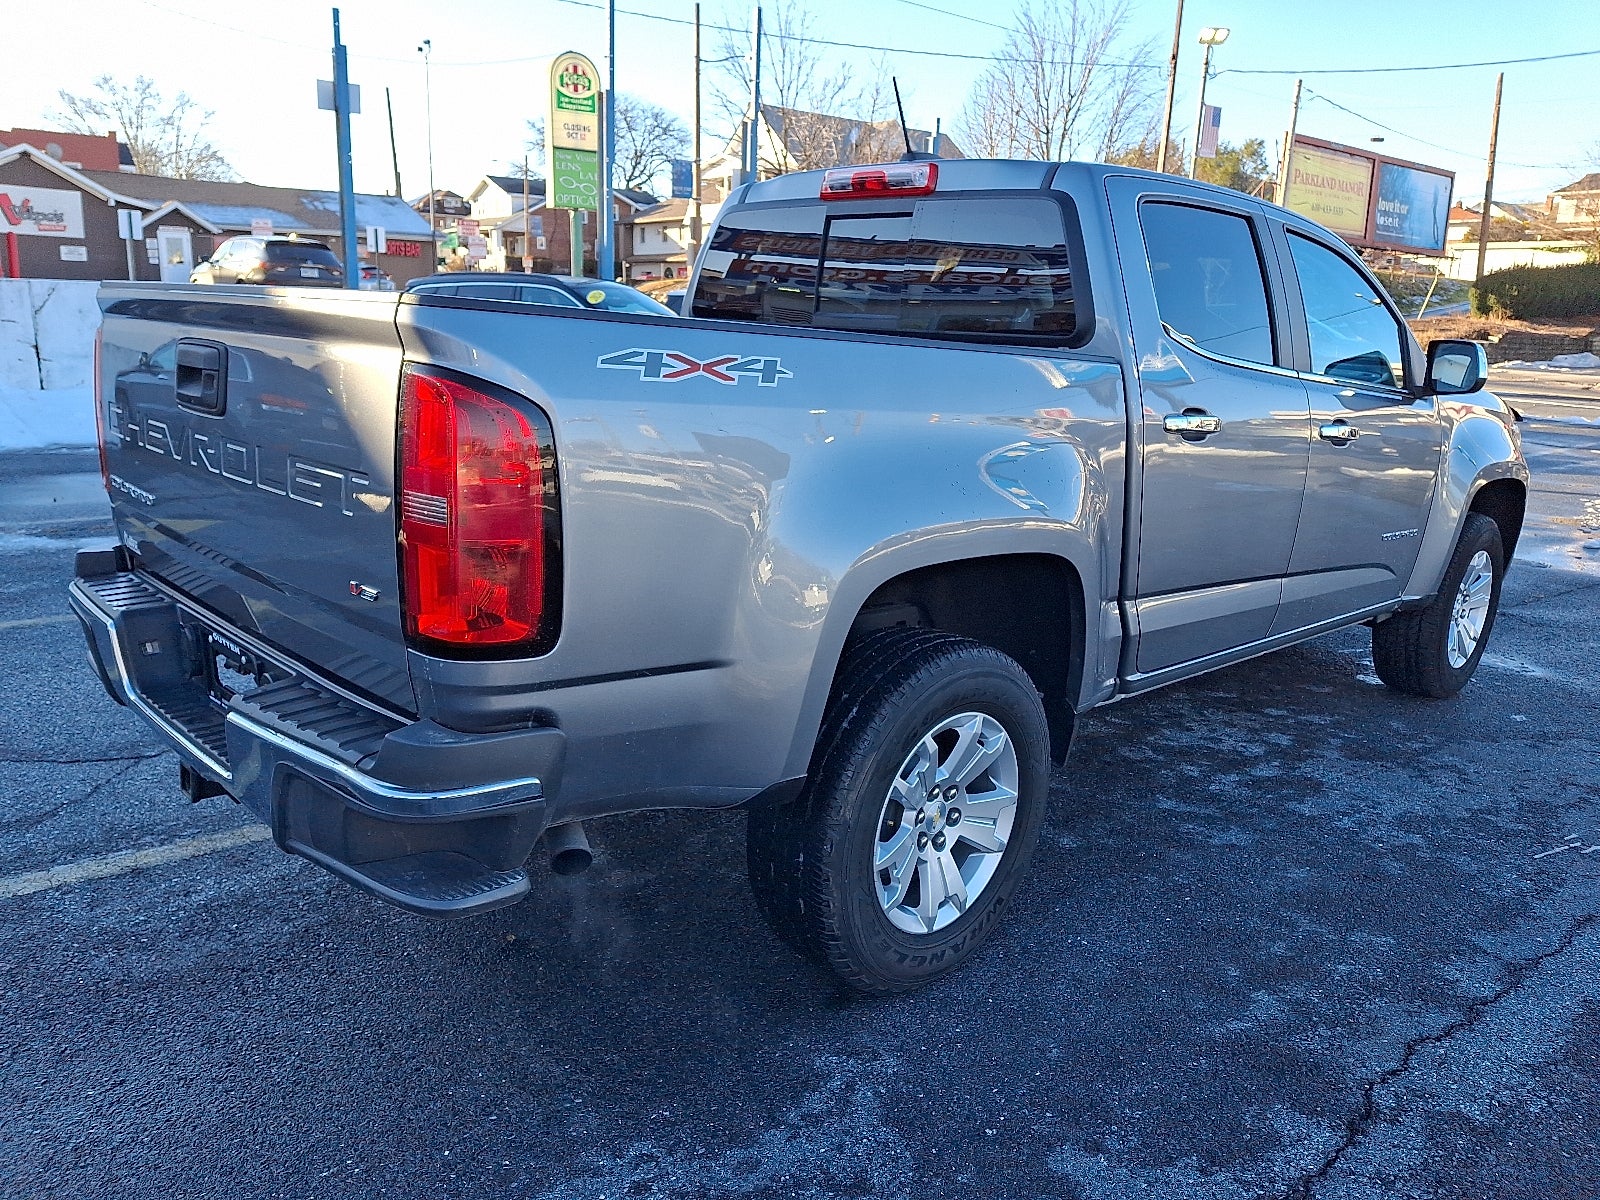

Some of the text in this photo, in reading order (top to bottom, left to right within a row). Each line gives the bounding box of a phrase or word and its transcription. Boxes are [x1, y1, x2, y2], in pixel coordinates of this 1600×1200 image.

[555, 161, 581, 171] LENS
[1294, 168, 1364, 197] PARKLAND MANOR
[1378, 197, 1394, 213] love
[1376, 212, 1400, 228] lose it
[405, 242, 422, 257] BAR
[109, 400, 370, 517] CHEVROLET
